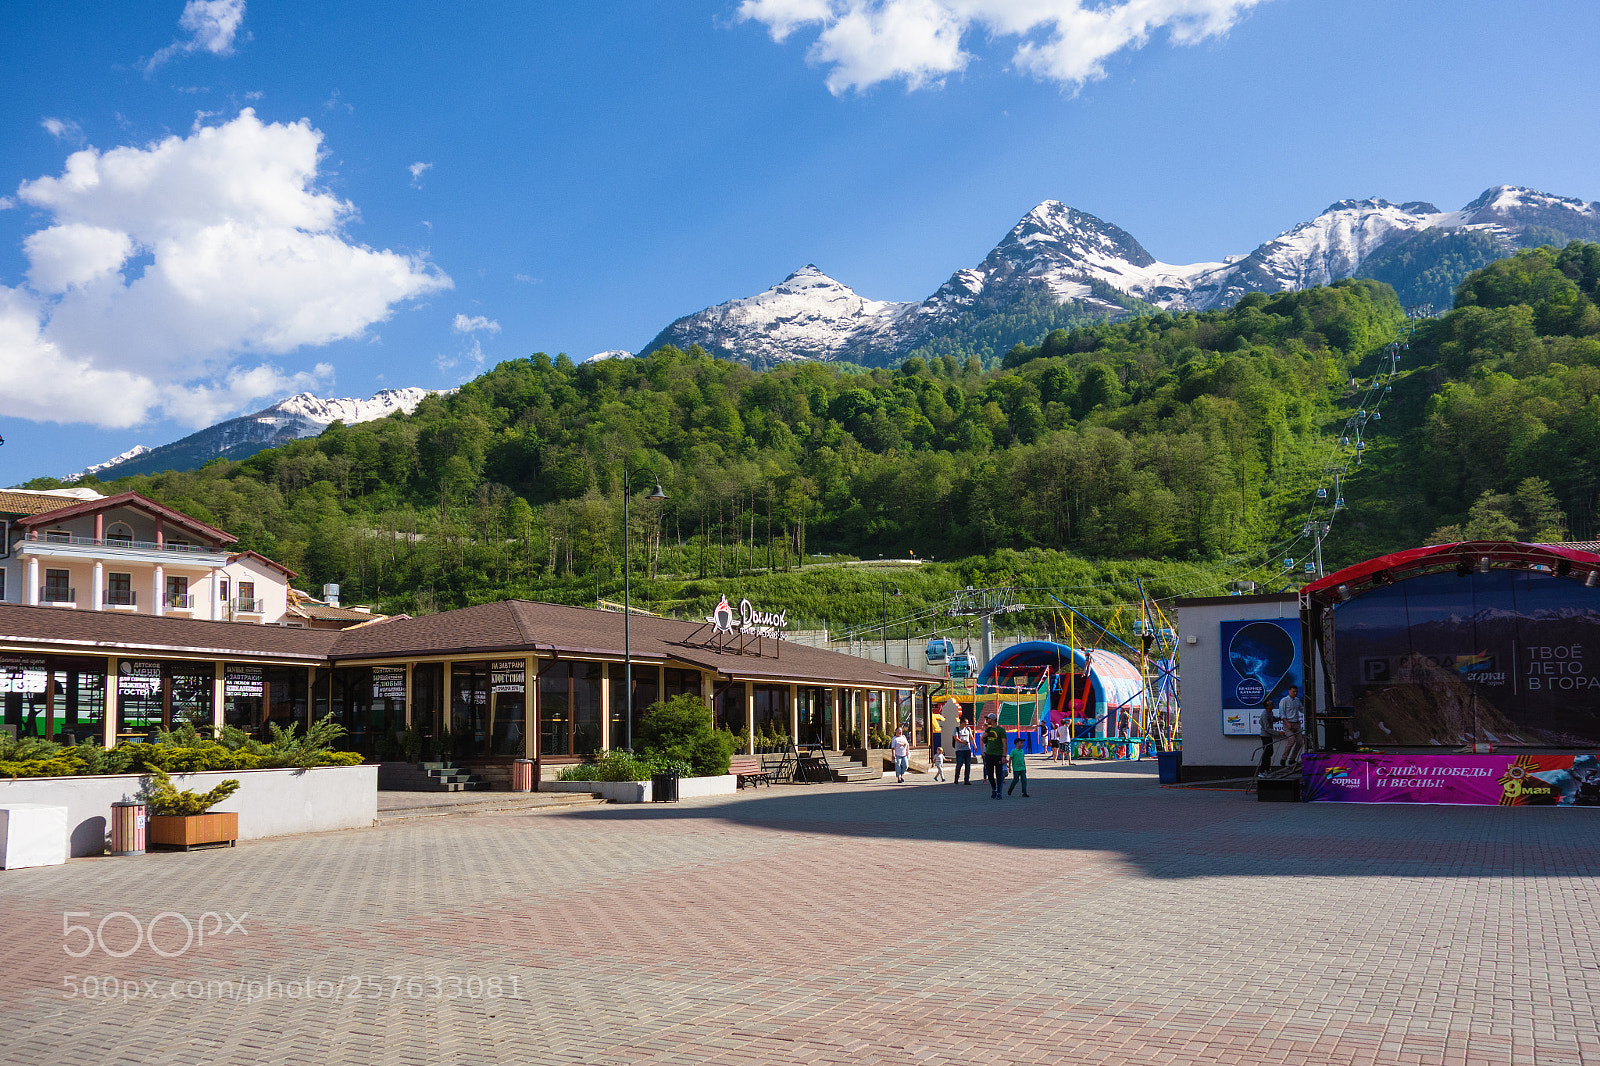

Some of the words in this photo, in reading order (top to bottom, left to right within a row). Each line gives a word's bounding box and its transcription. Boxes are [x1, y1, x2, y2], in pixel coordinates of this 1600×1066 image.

[740, 598, 788, 627] Дымок
[1527, 643, 1583, 660] ТВОЁ
[1527, 661, 1583, 675] ЛЕТО
[1467, 671, 1506, 684] горки
[1528, 677, 1542, 690] В
[1376, 767, 1385, 776] С
[1385, 765, 1427, 777] ДНЁМ
[1427, 766, 1494, 778] ПОБЕДЫ
[1331, 777, 1361, 787] горки
[1376, 778, 1389, 788] И
[1390, 778, 1445, 788] ВЕСНЫ!
[1503, 780, 1522, 798] 9
[1522, 787, 1551, 795] мая
